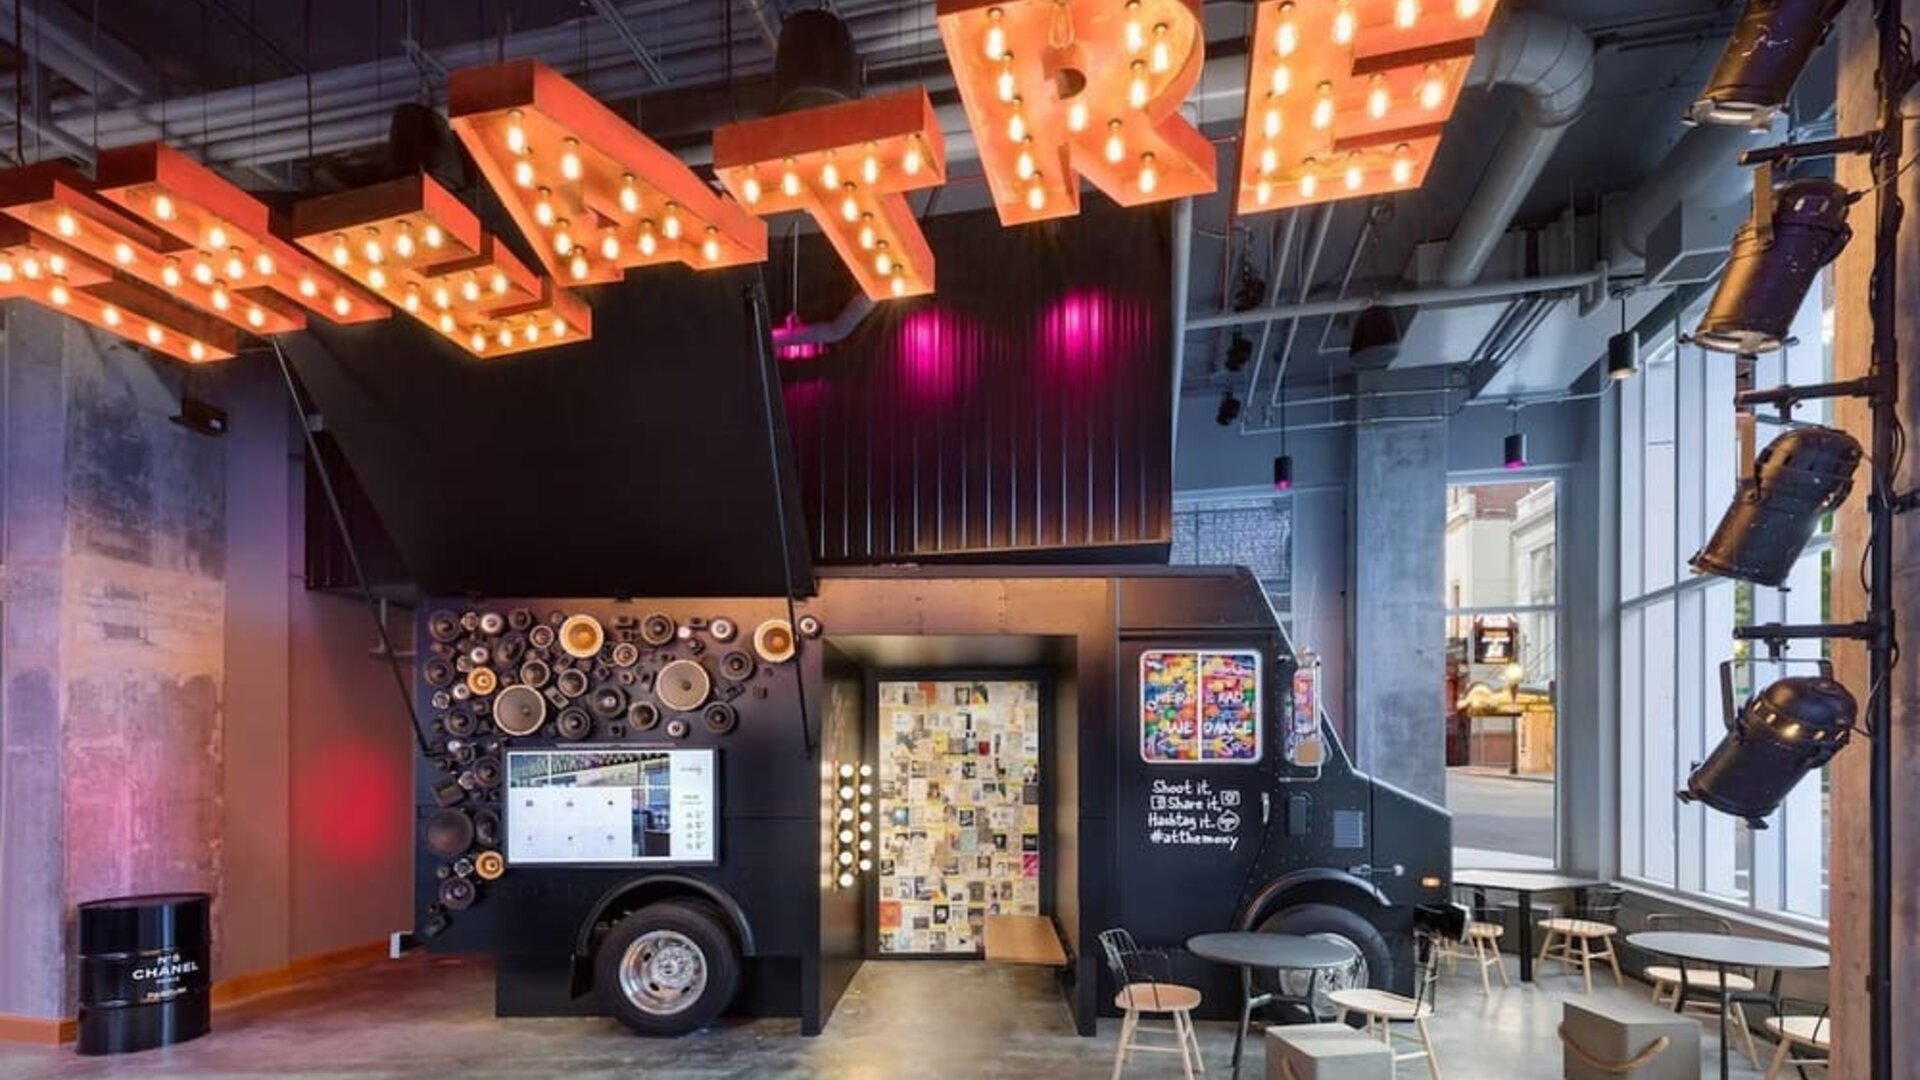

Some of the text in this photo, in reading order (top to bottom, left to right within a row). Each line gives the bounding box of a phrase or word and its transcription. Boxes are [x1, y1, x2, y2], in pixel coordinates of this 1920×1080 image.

[1152, 778, 1193, 795] Shoot
[1167, 795, 1204, 810] Share
[1147, 811, 1197, 831] Hashtag
[131, 961, 199, 981] CHANEL
